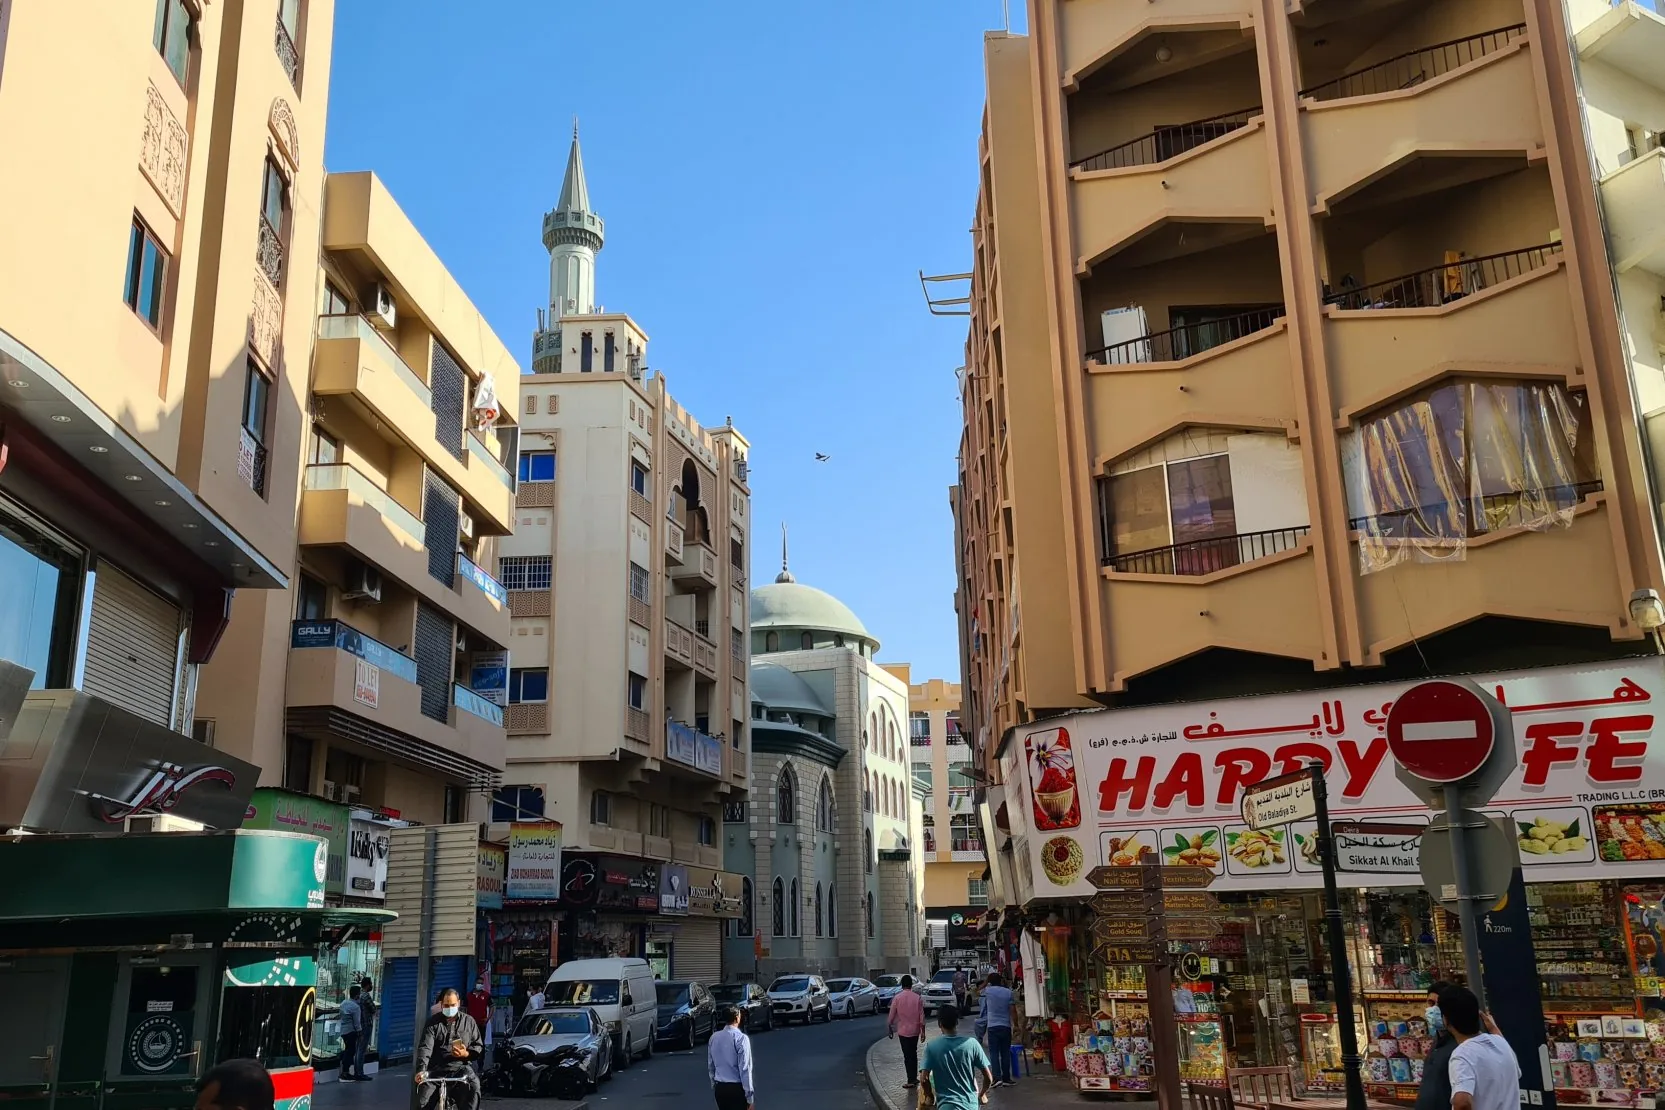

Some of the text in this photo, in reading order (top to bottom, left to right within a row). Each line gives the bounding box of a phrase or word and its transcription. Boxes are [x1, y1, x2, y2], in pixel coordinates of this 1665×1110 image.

[243, 446, 253, 463] LET
[298, 626, 331, 636] GALLY
[358, 663, 378, 690] TO LET
[1183, 700, 1345, 740] لايف
[1088, 737, 1109, 748] (فرع)
[1151, 731, 1177, 743] للتجارة
[1099, 714, 1654, 812] HAPPY FE
[1256, 782, 1311, 808] شارع البلدية القديم
[1577, 792, 1620, 802] TRADING
[1622, 790, 1646, 800] L.L.C
[1258, 805, 1298, 822] Old Baladiya St.
[1343, 826, 1360, 834] Deira
[1339, 836, 1420, 852] ارع سكة الخيل
[1349, 855, 1378, 865] Sikkat
[1380, 856, 1390, 865] Al
[1391, 856, 1414, 866] Khail
[476, 877, 502, 893] RASOUL
[1103, 877, 1140, 886] Naif Souq
[1187, 876, 1204, 884] Souq
[1493, 925, 1512, 933] 220m
